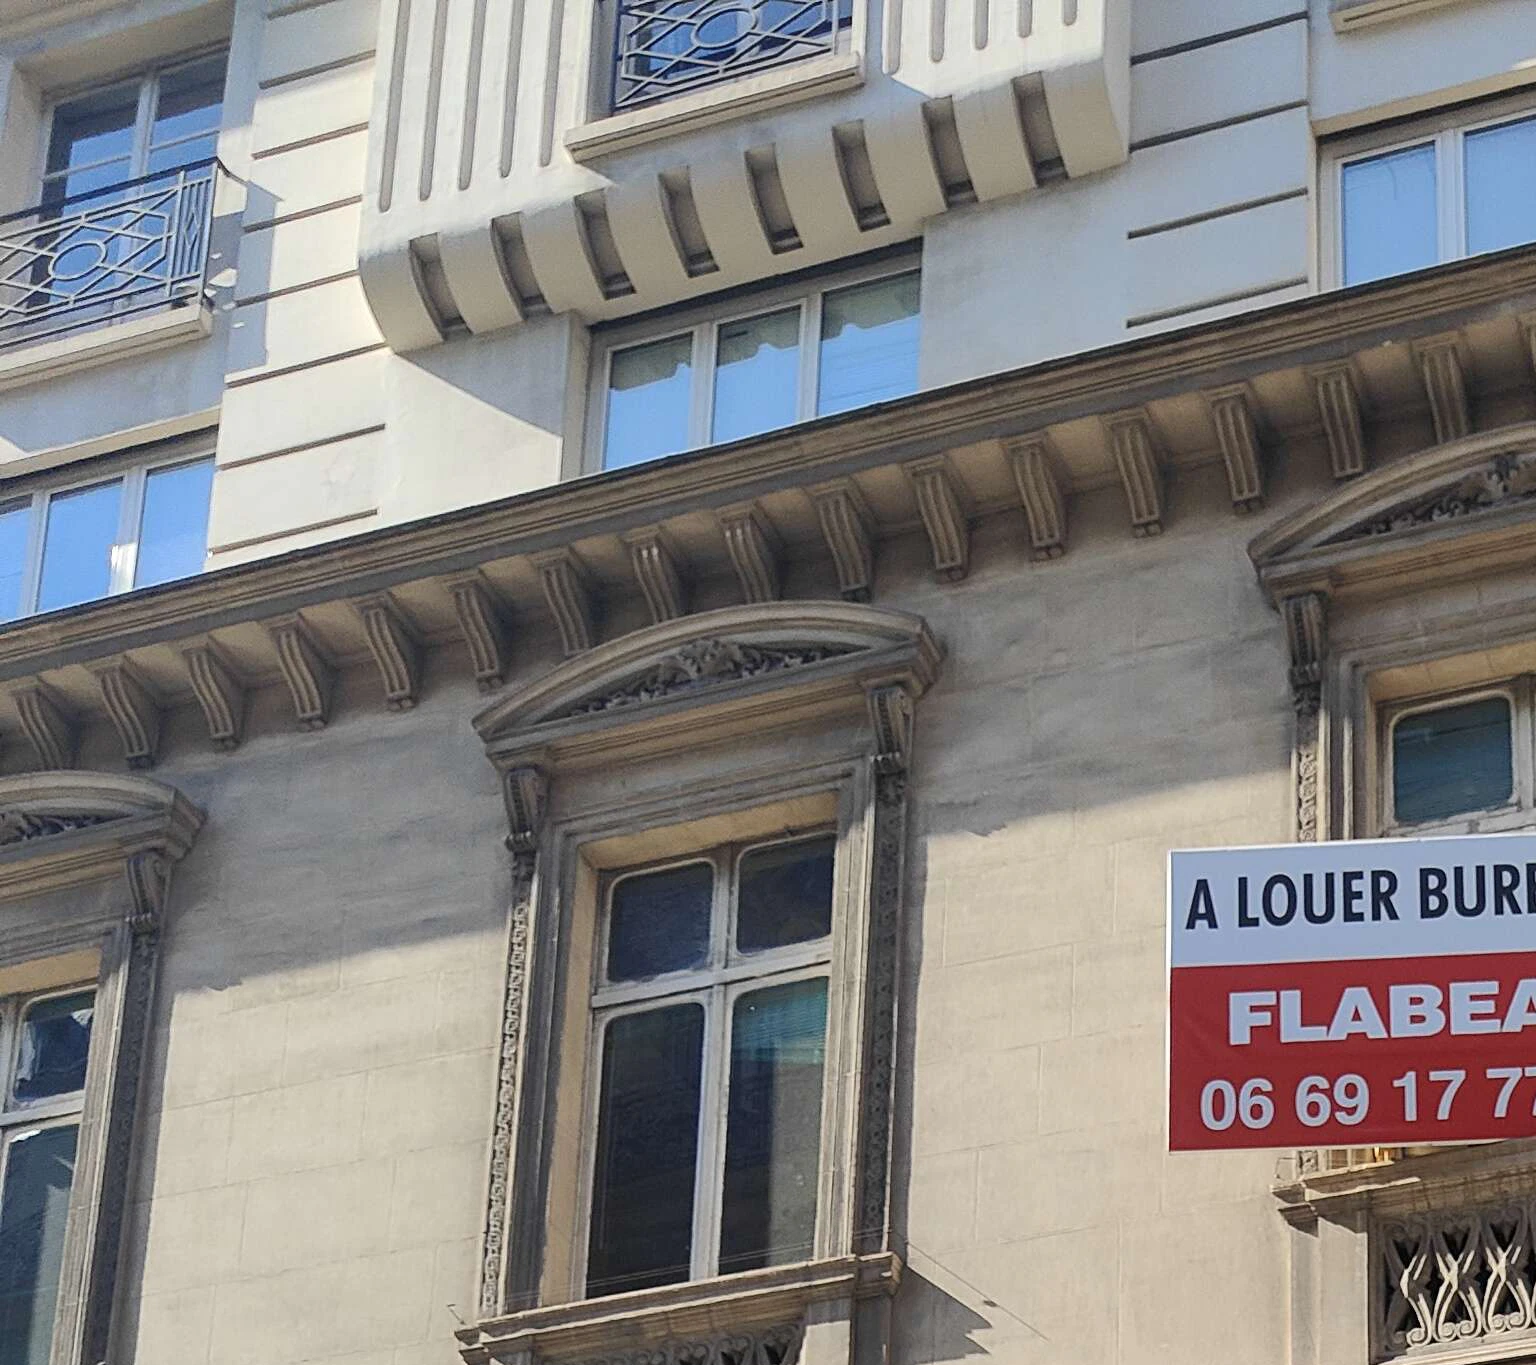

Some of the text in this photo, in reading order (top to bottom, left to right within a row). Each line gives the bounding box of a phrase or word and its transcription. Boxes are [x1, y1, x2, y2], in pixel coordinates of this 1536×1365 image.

[1185, 879, 1219, 930] A
[1237, 868, 1400, 928] LOUER
[1201, 1077, 1275, 1132] 06
[1295, 1073, 1369, 1127] 69
[1393, 1070, 1467, 1122] 17
